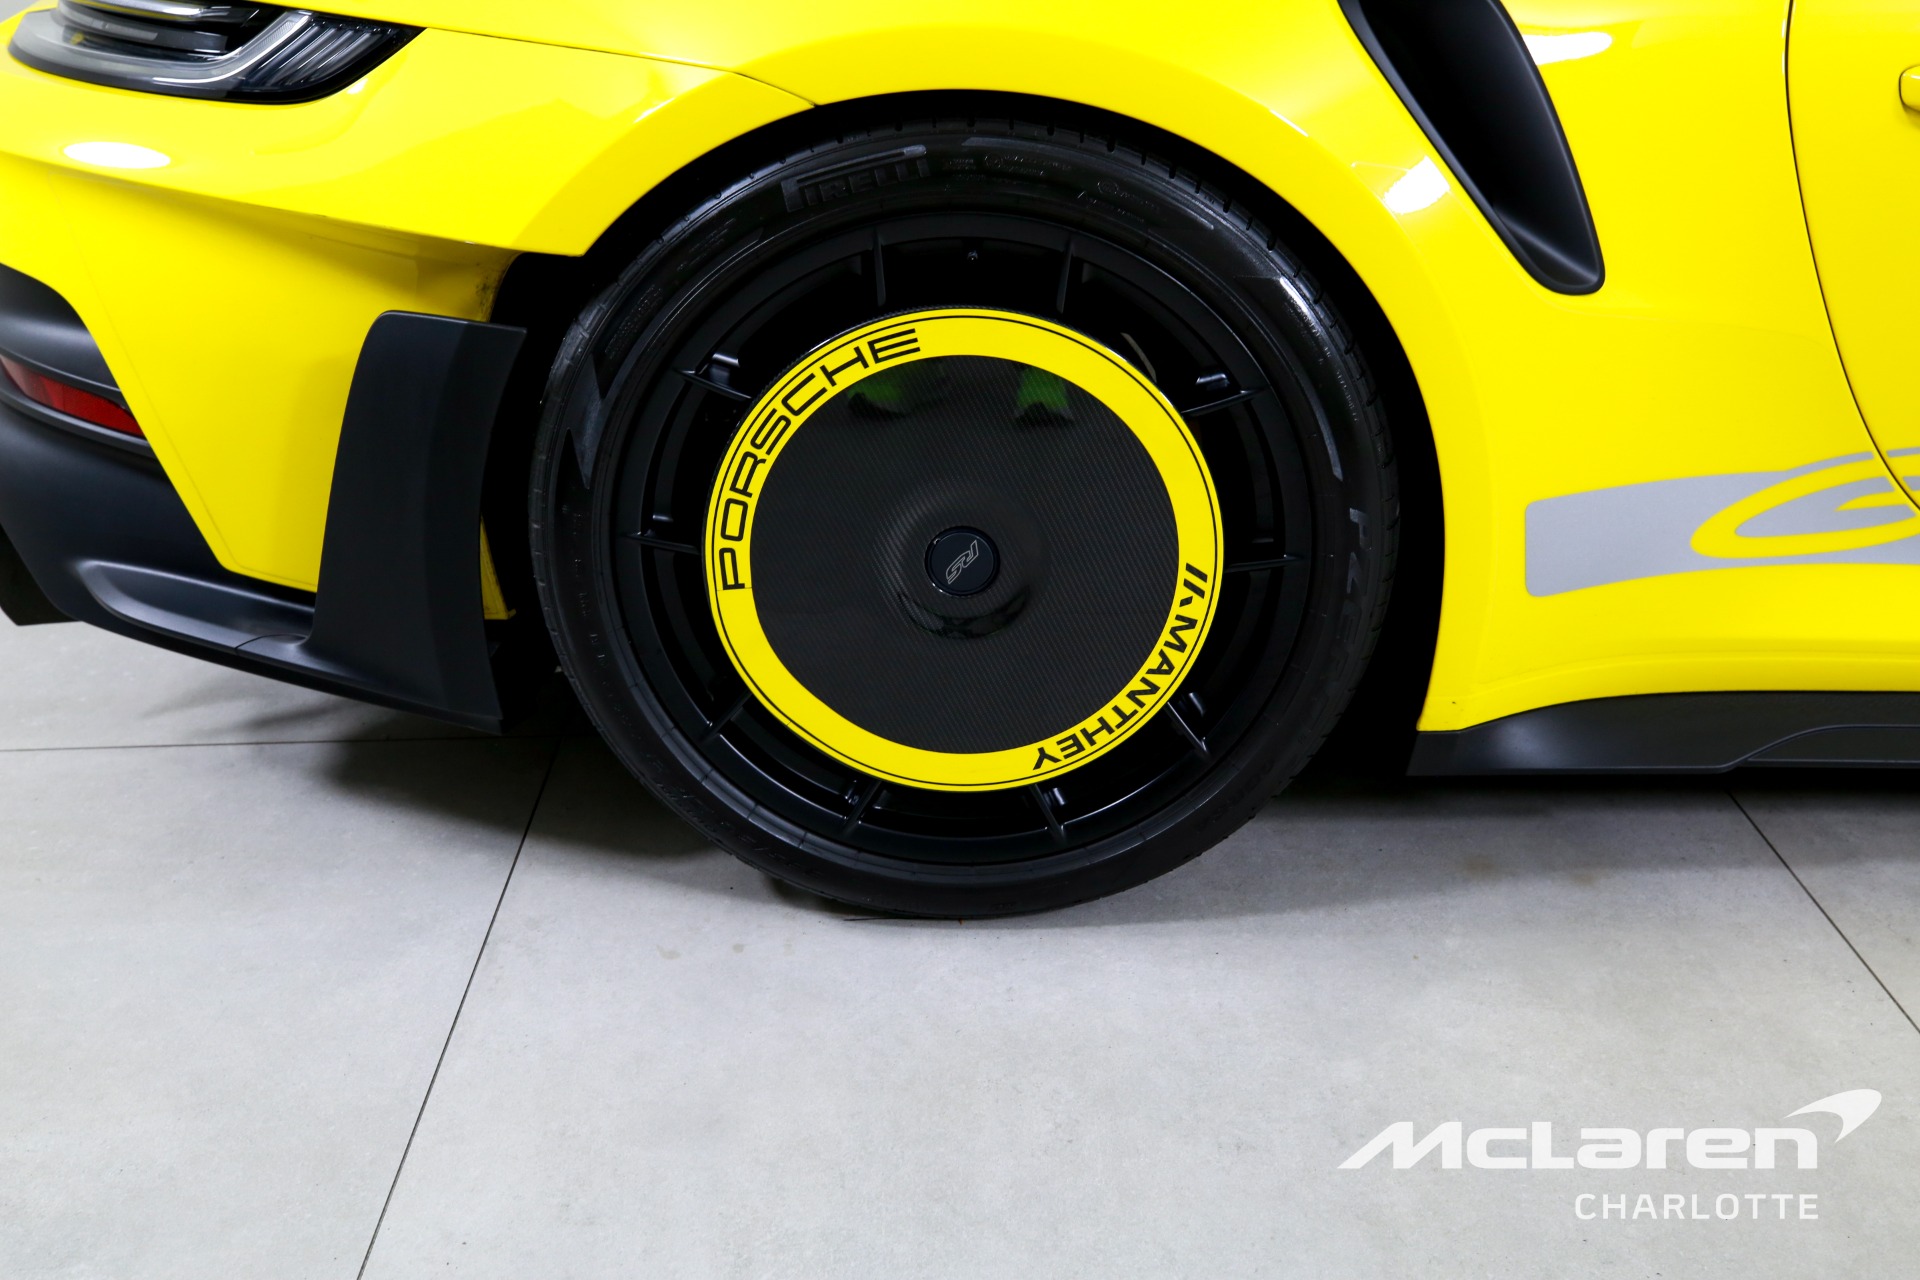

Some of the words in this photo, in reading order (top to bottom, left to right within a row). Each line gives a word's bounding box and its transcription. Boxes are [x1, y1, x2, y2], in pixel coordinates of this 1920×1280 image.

[781, 144, 931, 213] PIRELLI
[719, 328, 921, 591] PORSCHE
[945, 539, 979, 585] RS
[1032, 614, 1199, 771] MANTHEY
